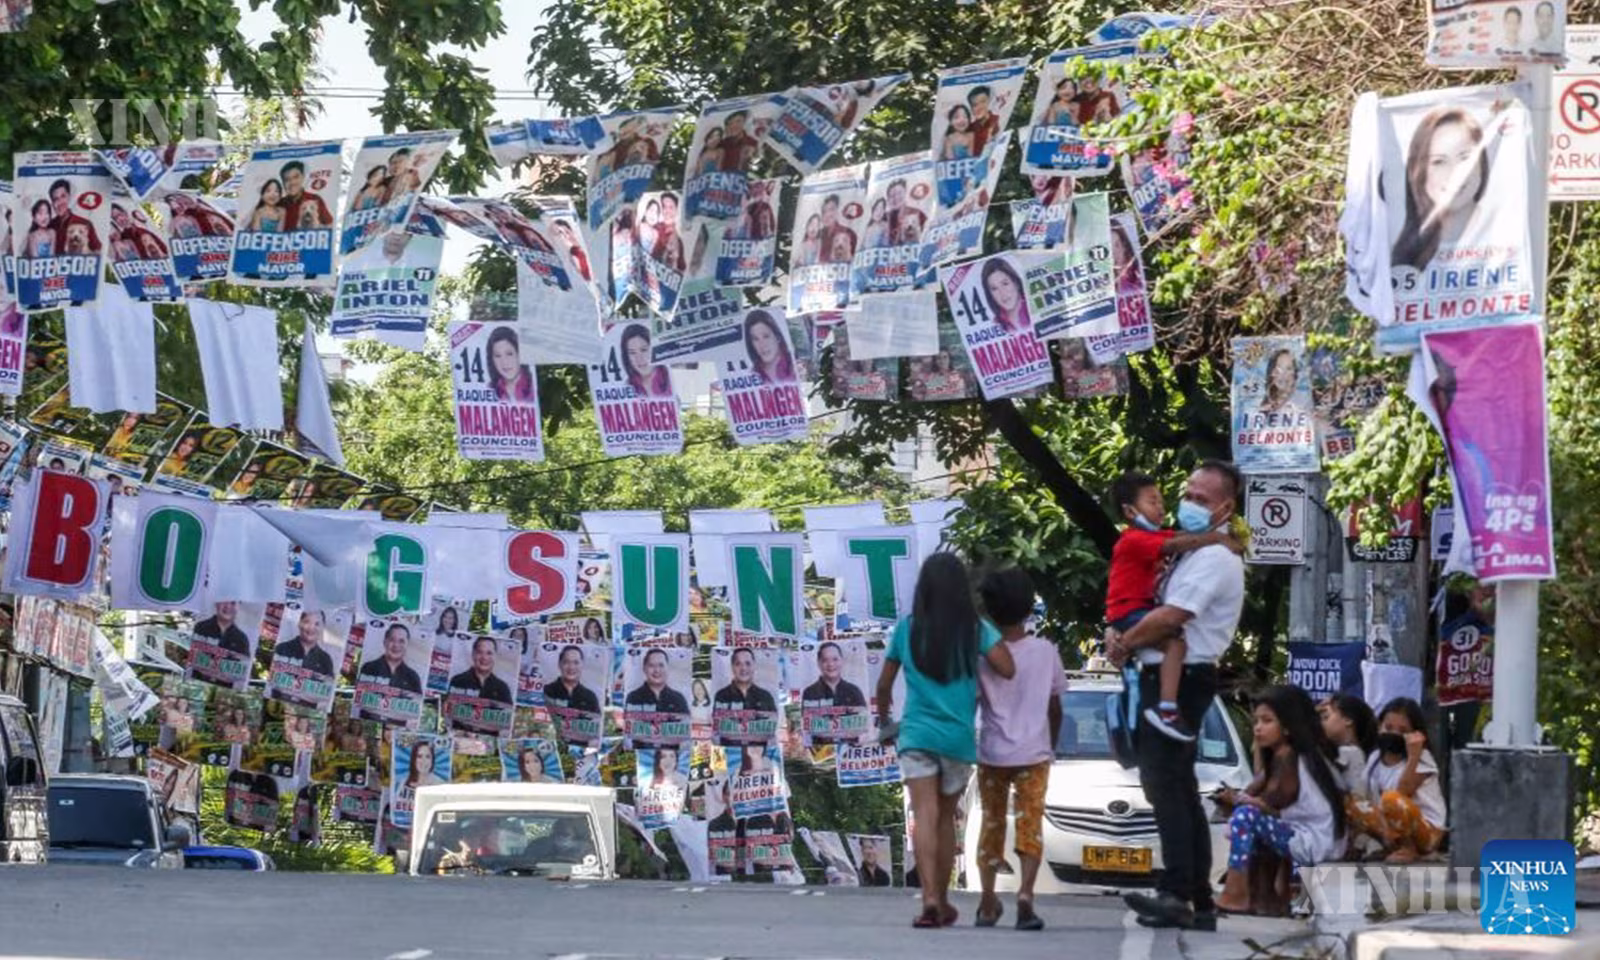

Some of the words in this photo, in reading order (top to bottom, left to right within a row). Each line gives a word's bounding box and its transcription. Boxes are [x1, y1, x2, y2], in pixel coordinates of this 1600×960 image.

[1550, 153, 1600, 170] ARK
[237, 230, 330, 251] DEFENSOR
[258, 263, 305, 274] MAYOR
[1430, 265, 1518, 290] IRENE
[342, 279, 419, 296] ARIEL
[342, 293, 430, 309] INTON
[1242, 412, 1308, 430] IRENE
[460, 436, 538, 448] COUNCILOR
[606, 432, 680, 443] COUNCILOR
[1238, 430, 1313, 445] BELMONTE
[1485, 508, 1535, 532] 4Ps
[1491, 553, 1546, 567] LIMA
